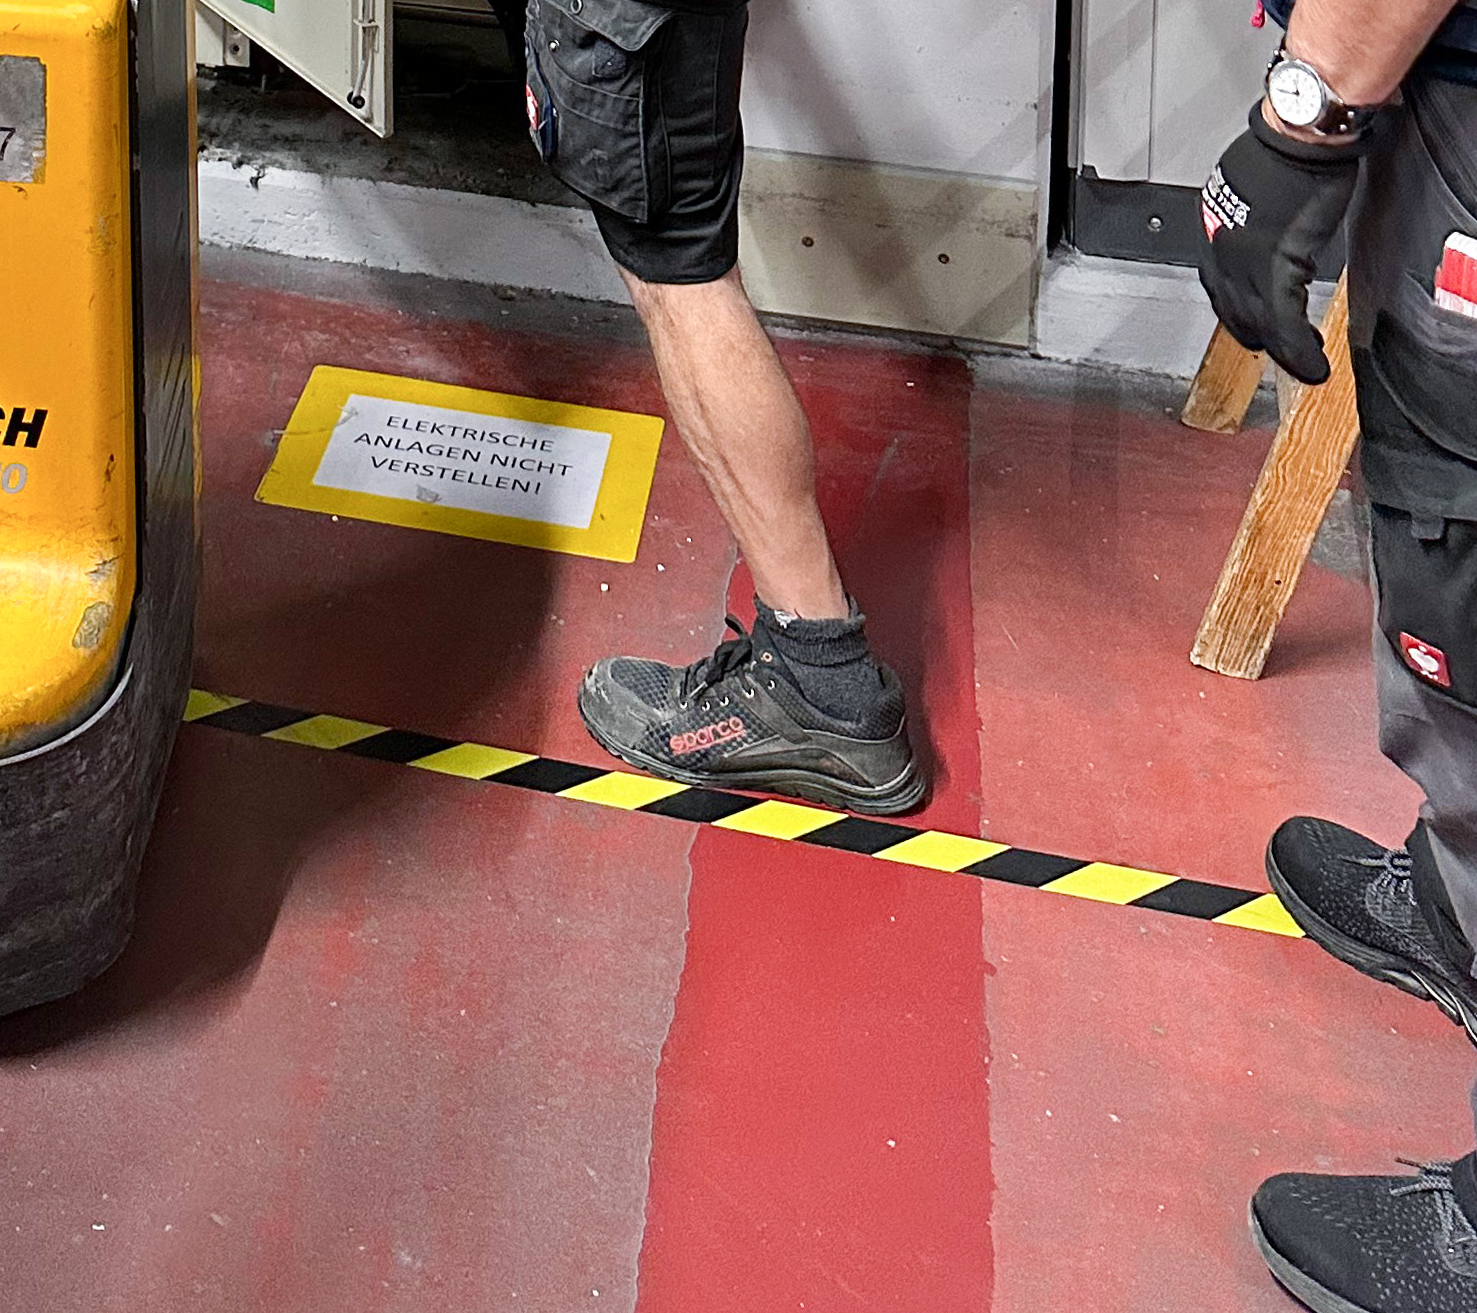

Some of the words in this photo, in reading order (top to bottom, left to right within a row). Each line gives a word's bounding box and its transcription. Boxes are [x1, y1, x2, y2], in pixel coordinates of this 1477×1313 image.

[386, 415, 555, 453] ELEKTRISCHE
[353, 432, 482, 463] ANLAGEN
[489, 452, 574, 477] NICHT
[370, 455, 542, 495] VERSTELLEN!
[669, 715, 744, 754] sparco
